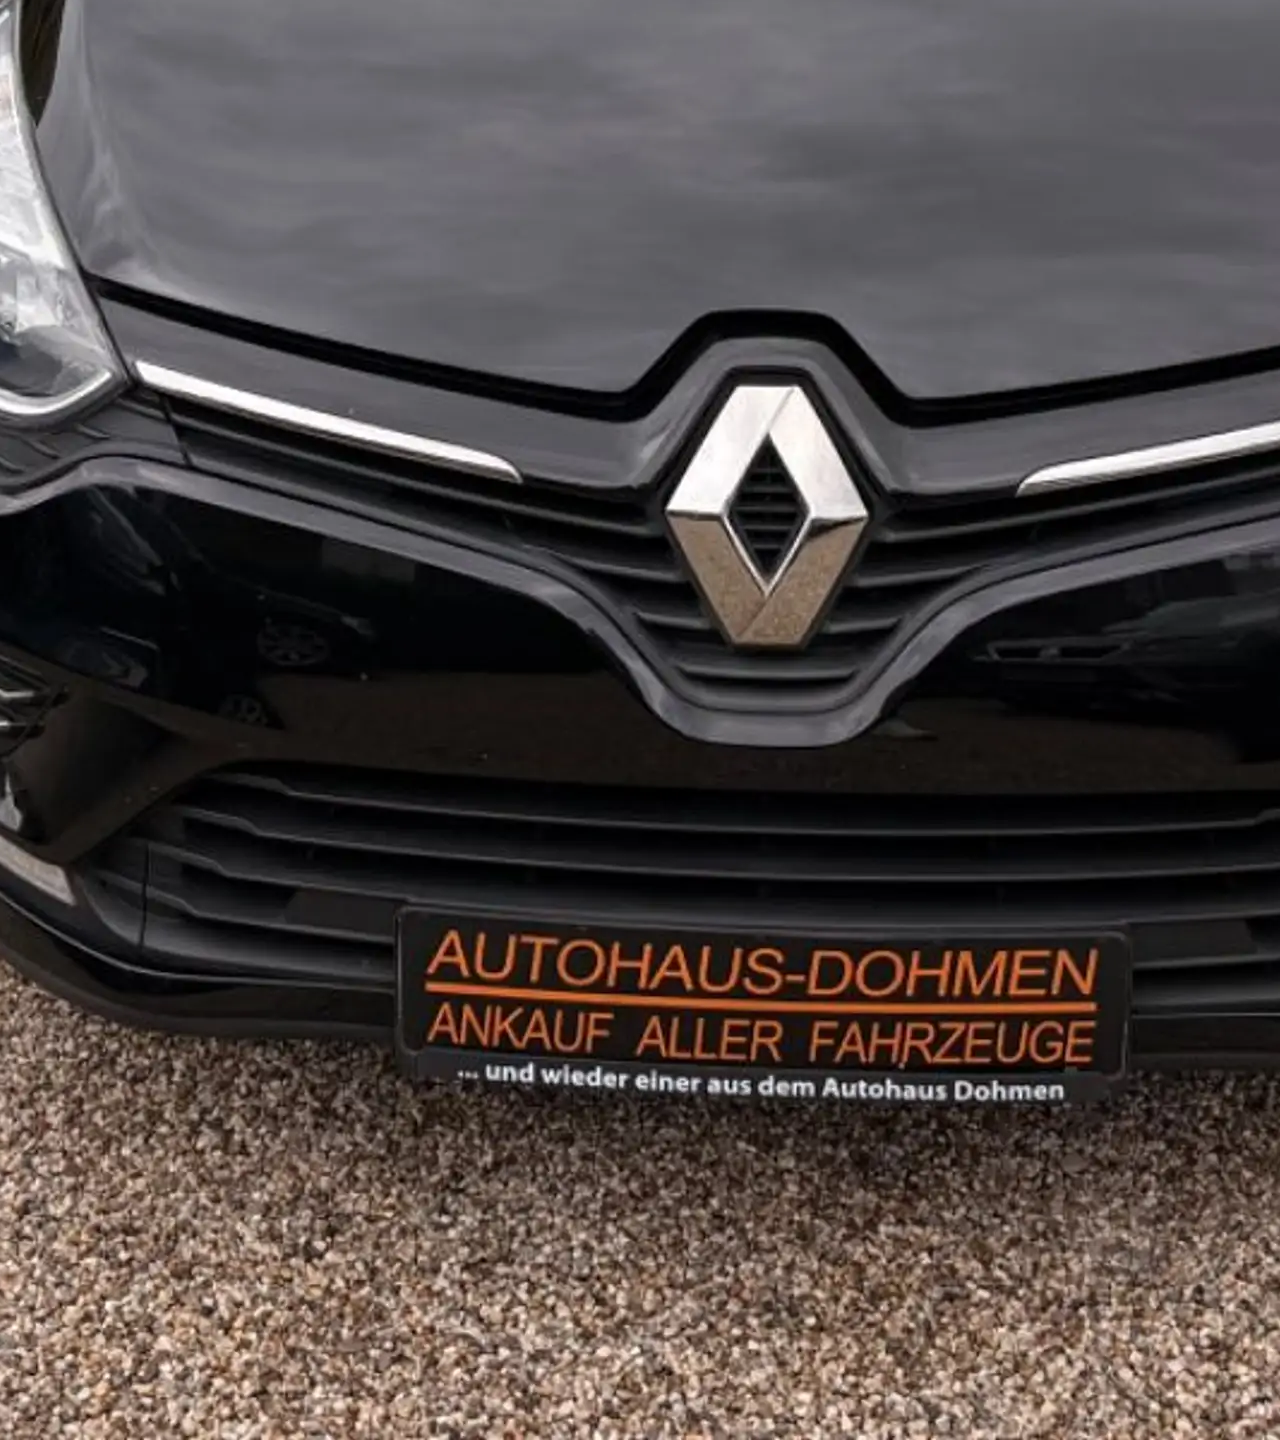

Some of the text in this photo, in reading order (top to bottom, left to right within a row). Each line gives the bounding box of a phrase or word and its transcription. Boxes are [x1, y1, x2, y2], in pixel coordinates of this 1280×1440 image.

[426, 928, 1099, 997] AUTOHAUS-DOHMEN
[427, 1001, 1097, 1066] ANKAUF ALLER FAHRZEUGE
[486, 1062, 535, 1084] und
[541, 1065, 629, 1089] wieder
[635, 1069, 701, 1093] einer
[708, 1076, 752, 1095] aus
[758, 1075, 815, 1098] dem
[822, 1076, 948, 1101] Autohaus
[955, 1080, 1065, 1102] Dohmen
